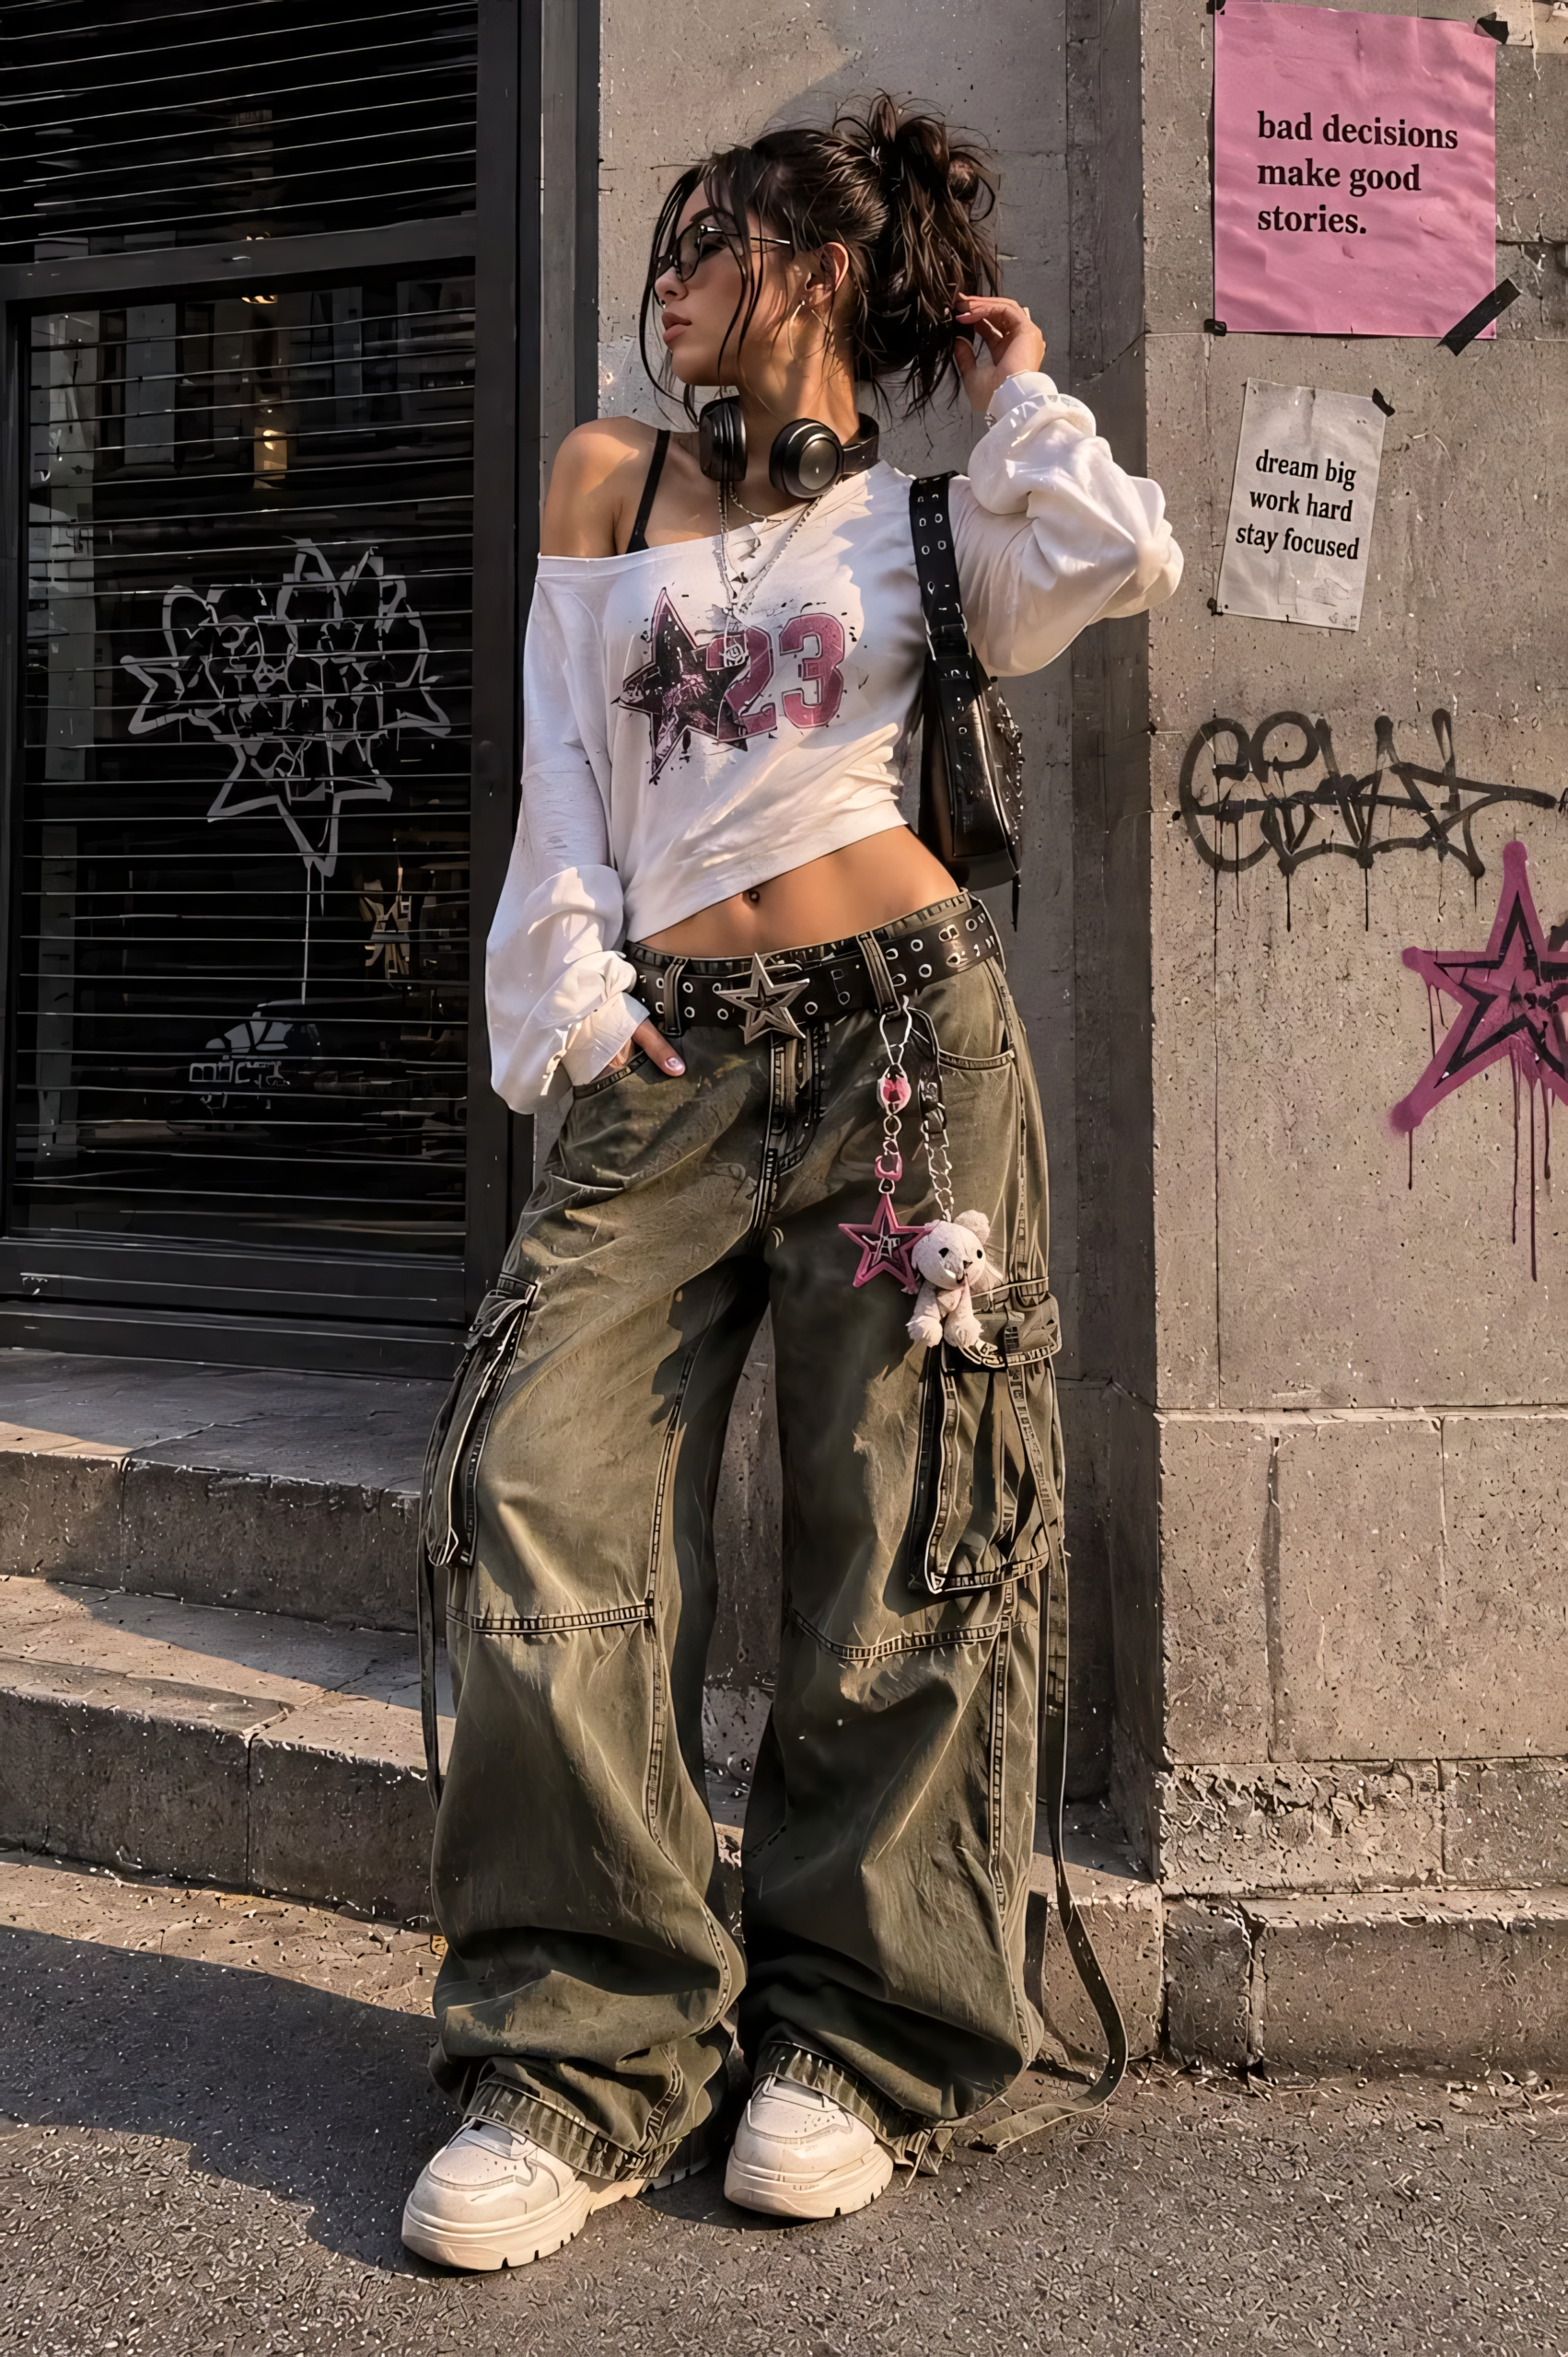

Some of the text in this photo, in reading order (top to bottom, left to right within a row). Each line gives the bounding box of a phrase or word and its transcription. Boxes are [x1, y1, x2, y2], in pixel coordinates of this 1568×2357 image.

[1257, 110, 1458, 150] bad decisions
[1257, 157, 1423, 198] make good
[1257, 203, 1367, 235] stories.
[1255, 448, 1357, 492] dream big
[1249, 490, 1353, 522] work hard
[1235, 523, 1360, 560] stay focused
[705, 613, 845, 743] 23
